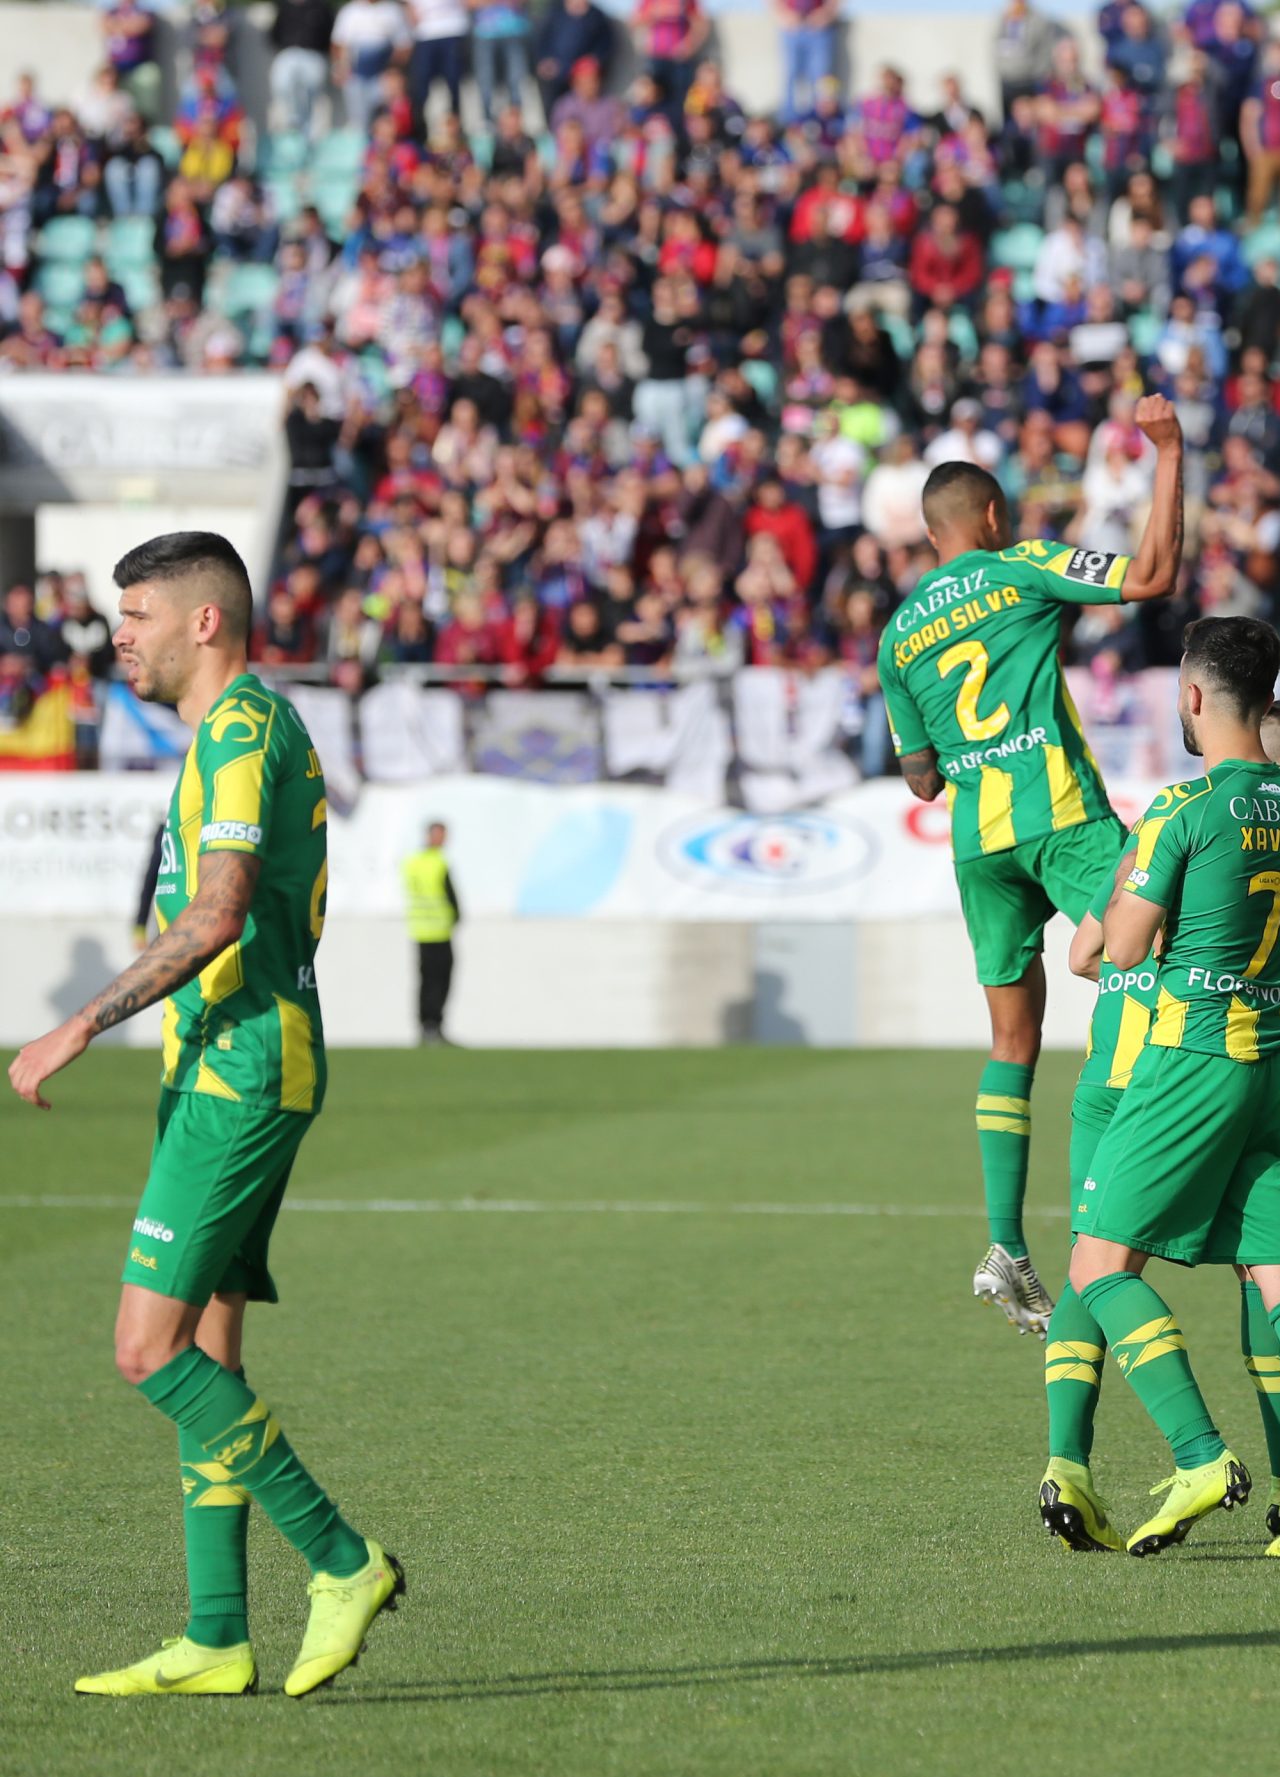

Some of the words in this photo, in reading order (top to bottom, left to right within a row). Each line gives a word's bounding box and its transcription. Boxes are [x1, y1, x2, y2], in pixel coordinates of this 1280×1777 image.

[896, 568, 990, 632] CABRIZ
[950, 586, 1022, 631] SILVA
[936, 640, 1010, 741] 2
